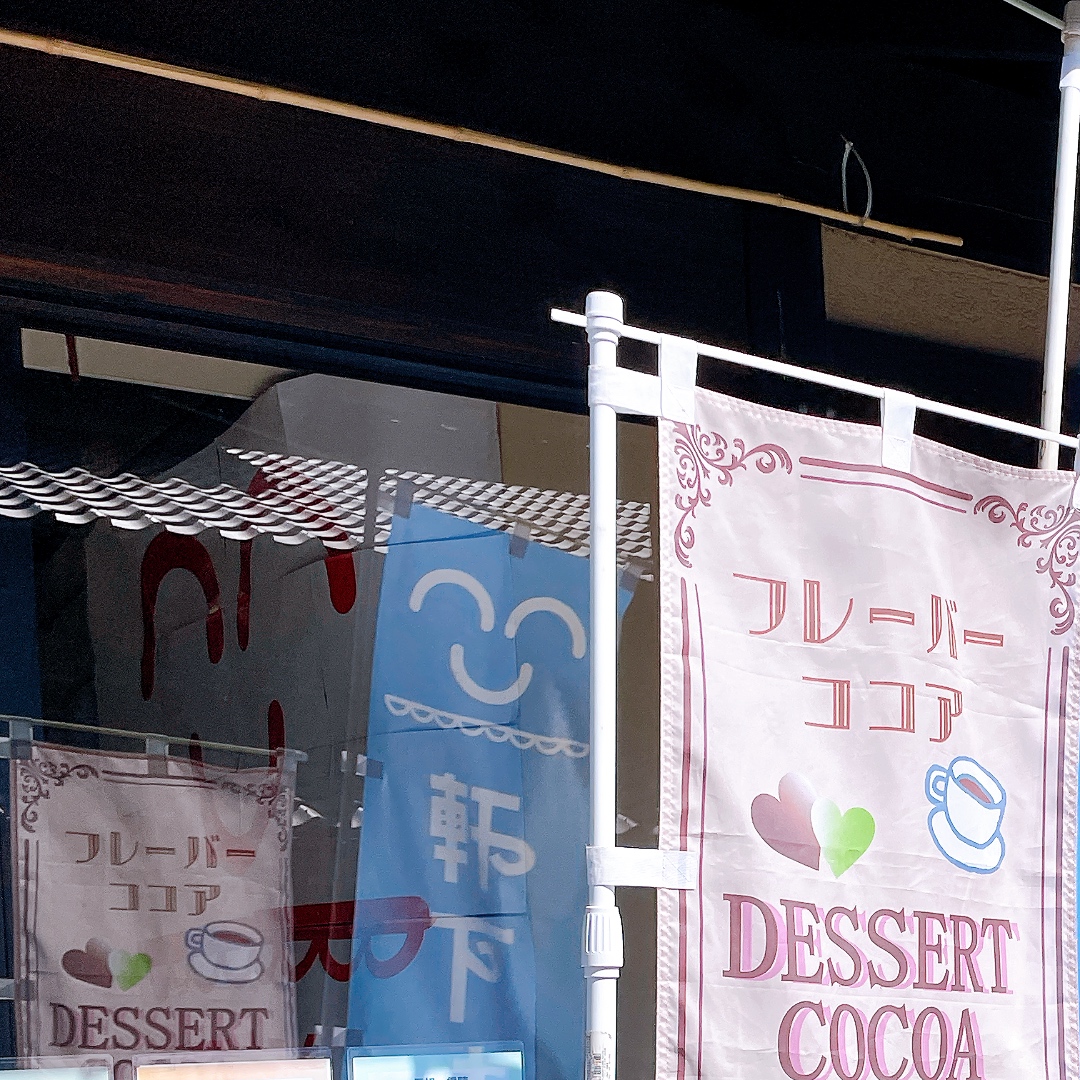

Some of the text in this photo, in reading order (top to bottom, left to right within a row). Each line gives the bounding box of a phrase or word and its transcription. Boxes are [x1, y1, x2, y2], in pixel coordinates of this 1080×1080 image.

[733, 573, 1004, 660] フレーバー
[802, 676, 963, 743] ココア
[65, 831, 256, 870] フレーバー
[109, 883, 221, 916] ココア
[722, 893, 1020, 995] DESSERT
[49, 1002, 270, 1051] DESSERT
